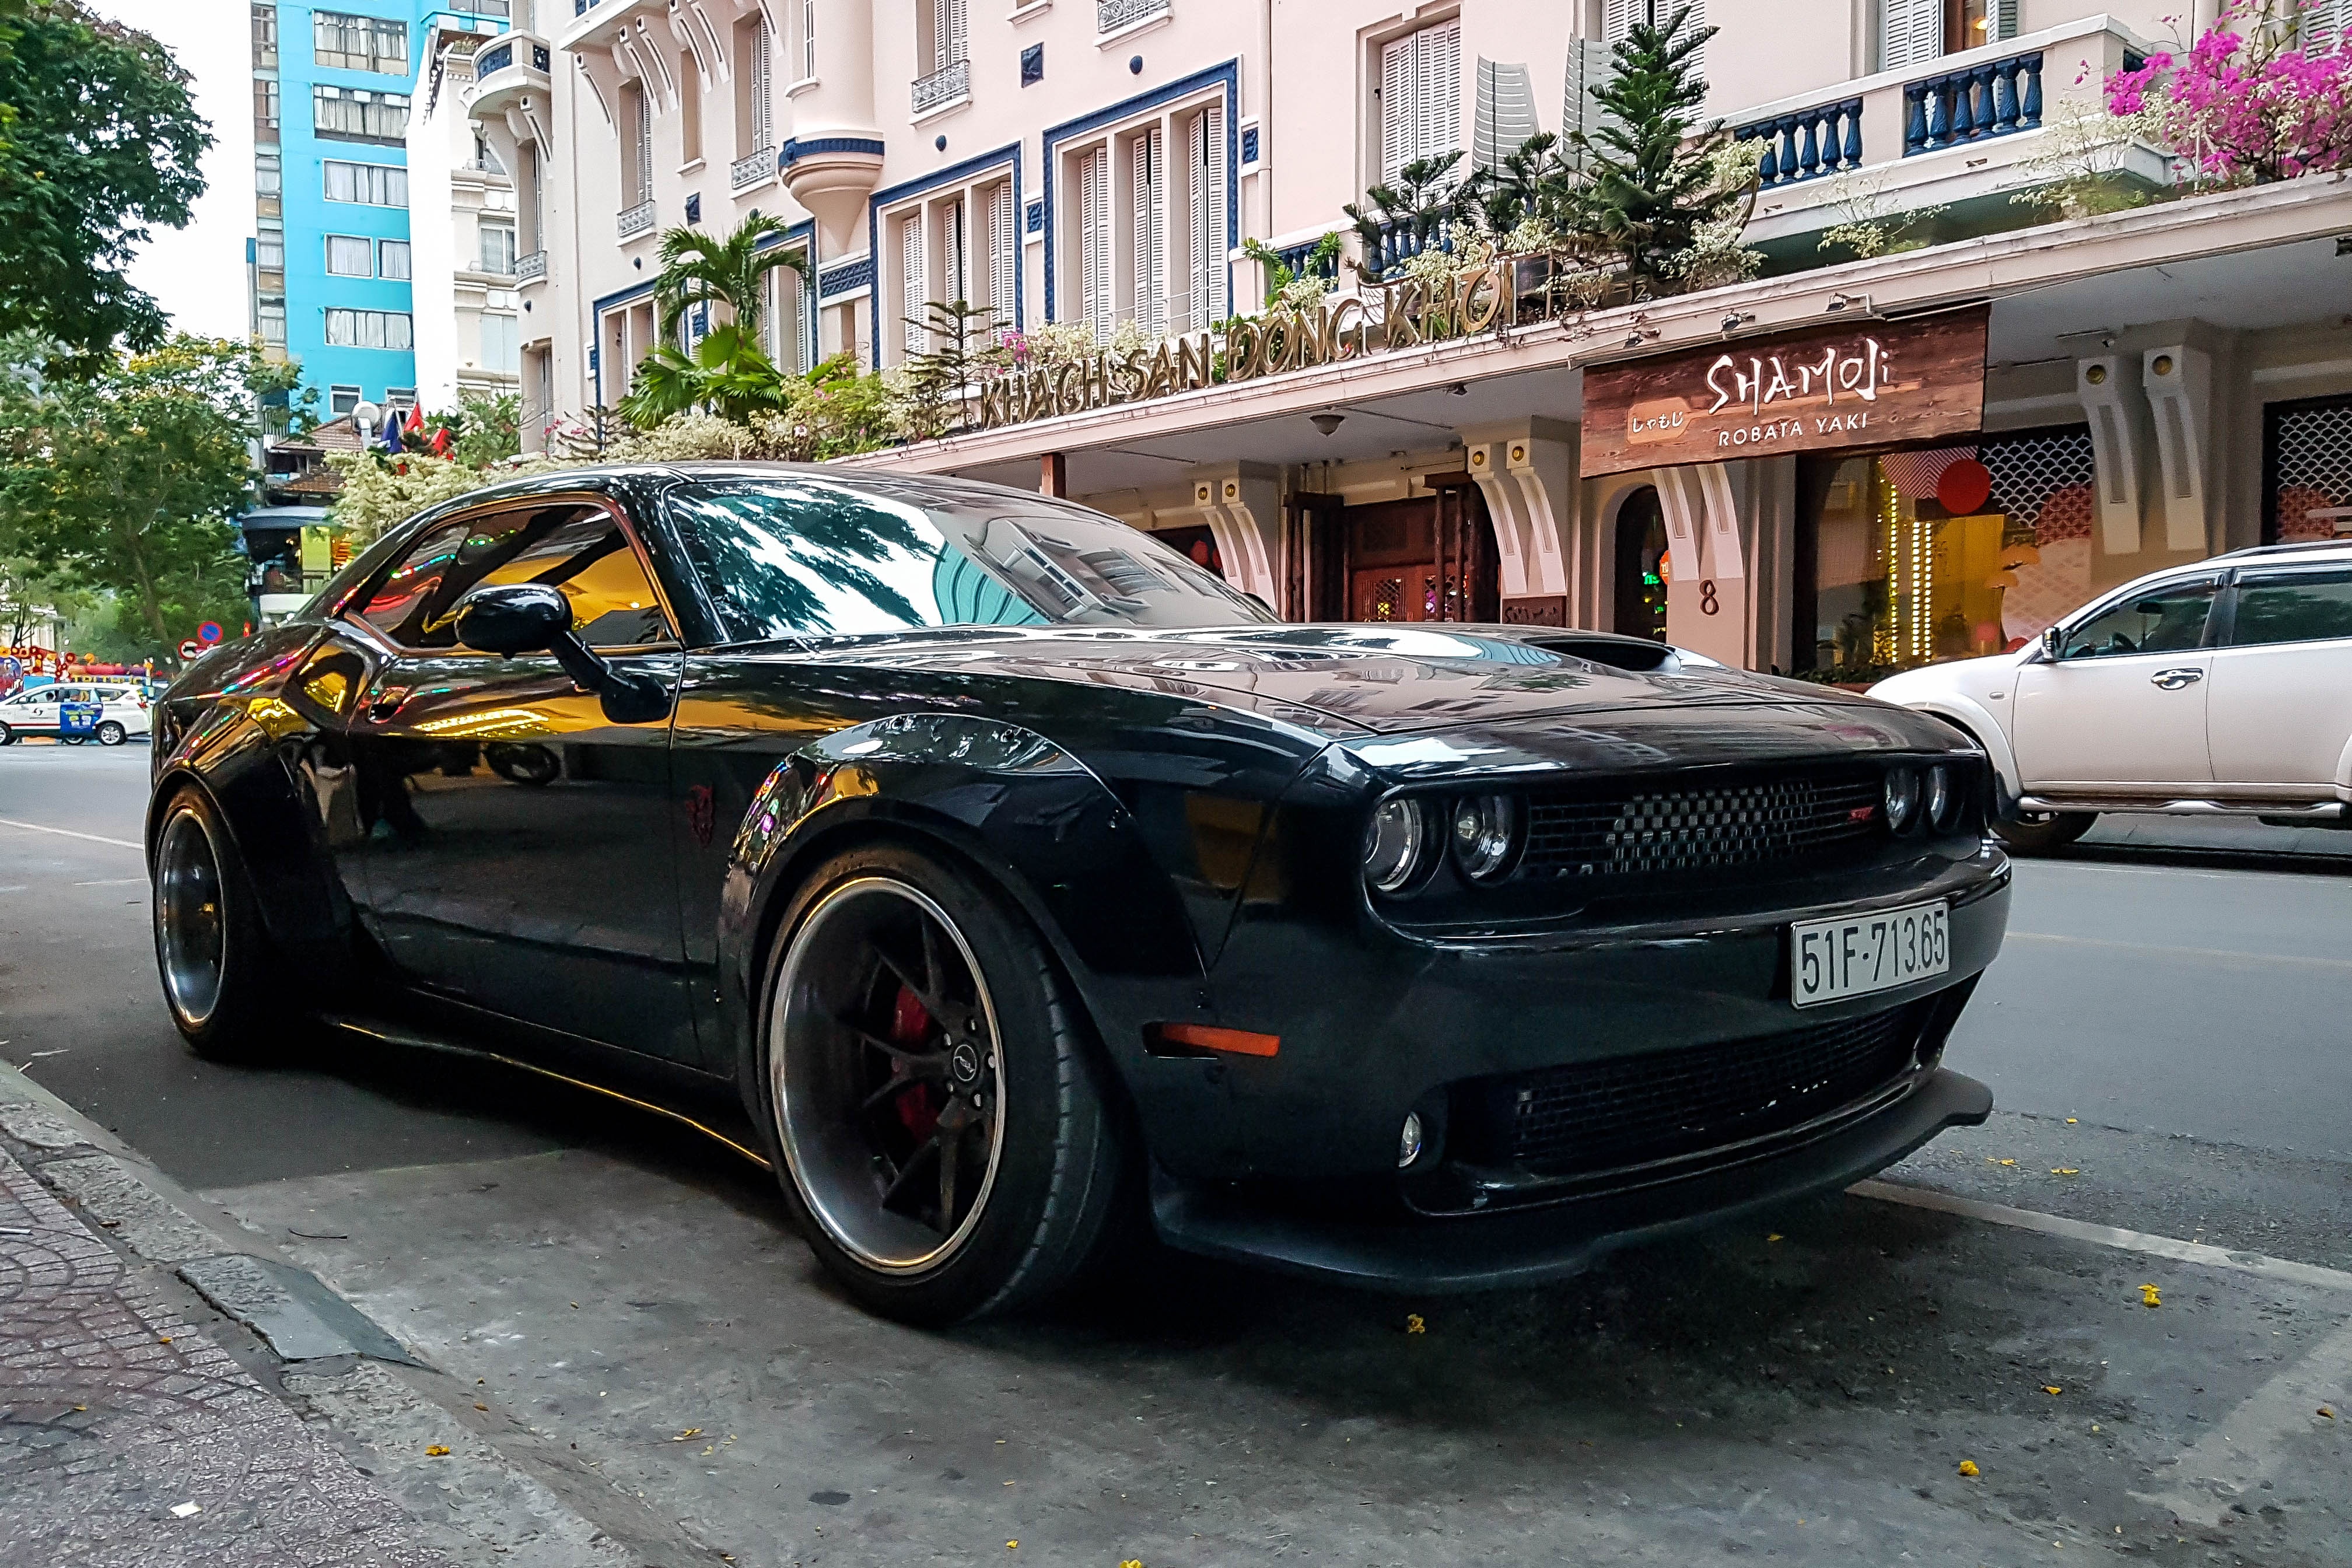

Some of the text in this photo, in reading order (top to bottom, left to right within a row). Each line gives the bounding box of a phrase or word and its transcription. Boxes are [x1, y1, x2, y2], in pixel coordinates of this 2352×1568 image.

[1632, 411, 1684, 433] しゃもじ
[1718, 412, 1867, 446] ROBATA YAKI
[1699, 579, 1720, 616] 8
